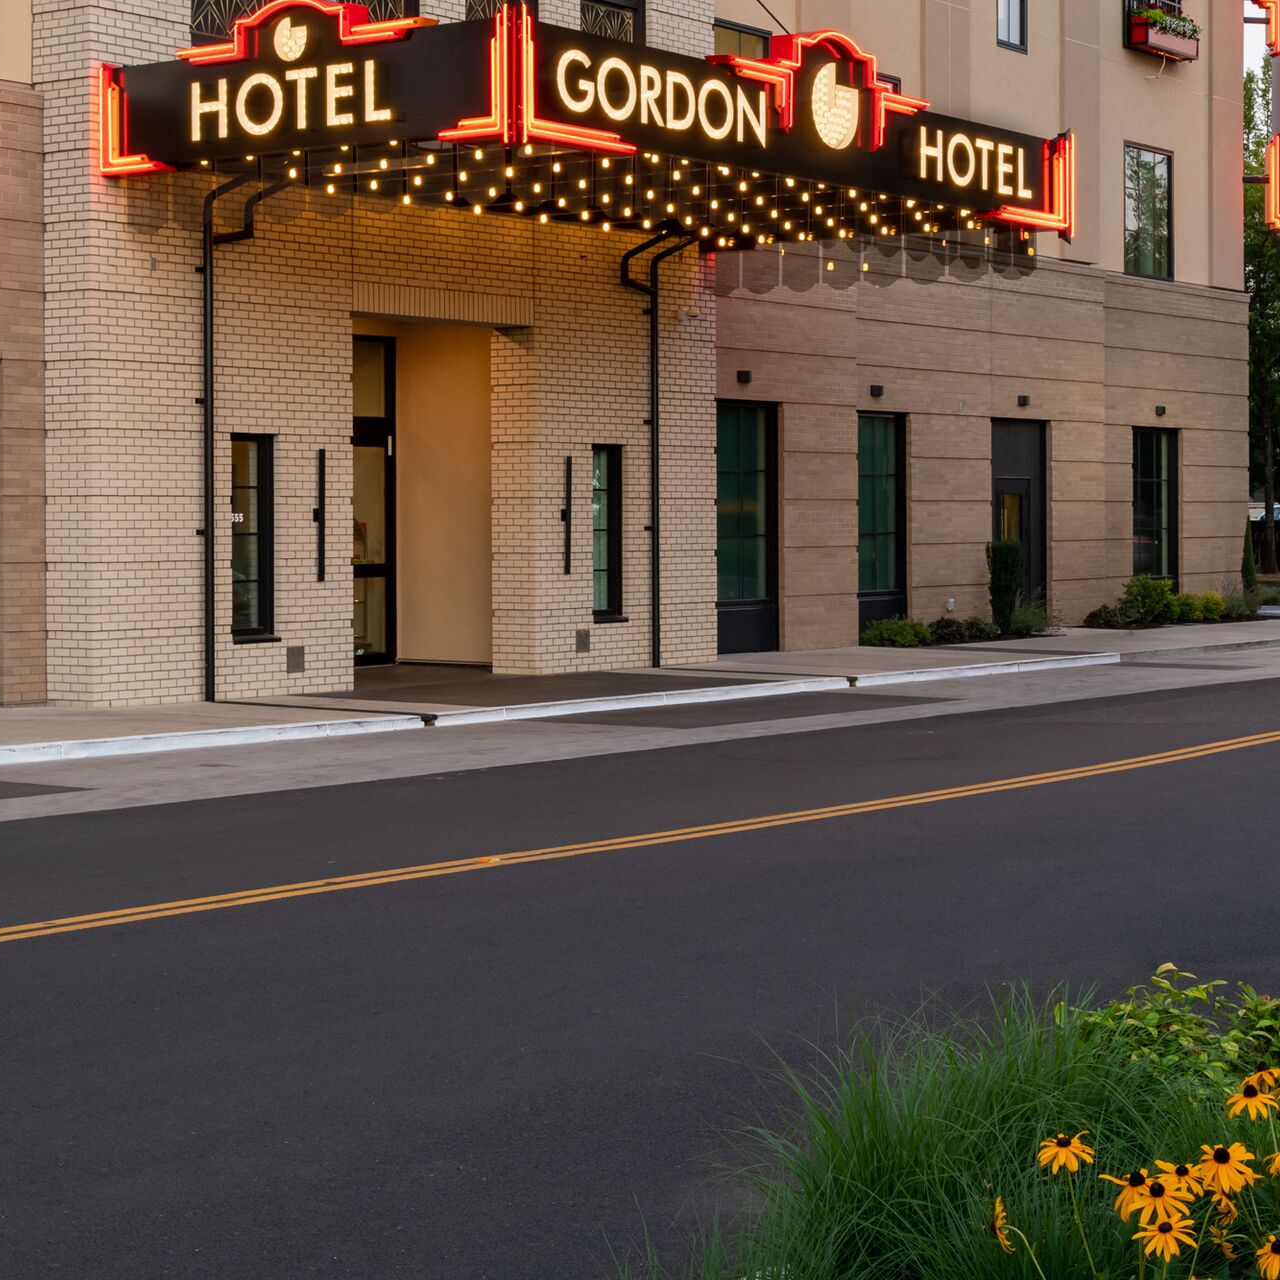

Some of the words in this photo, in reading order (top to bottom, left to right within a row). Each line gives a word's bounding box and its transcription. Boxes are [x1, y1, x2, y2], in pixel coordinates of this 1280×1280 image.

[190, 59, 392, 142] HOTEL
[556, 48, 767, 149] GORDON
[919, 124, 1033, 200] HOTEL
